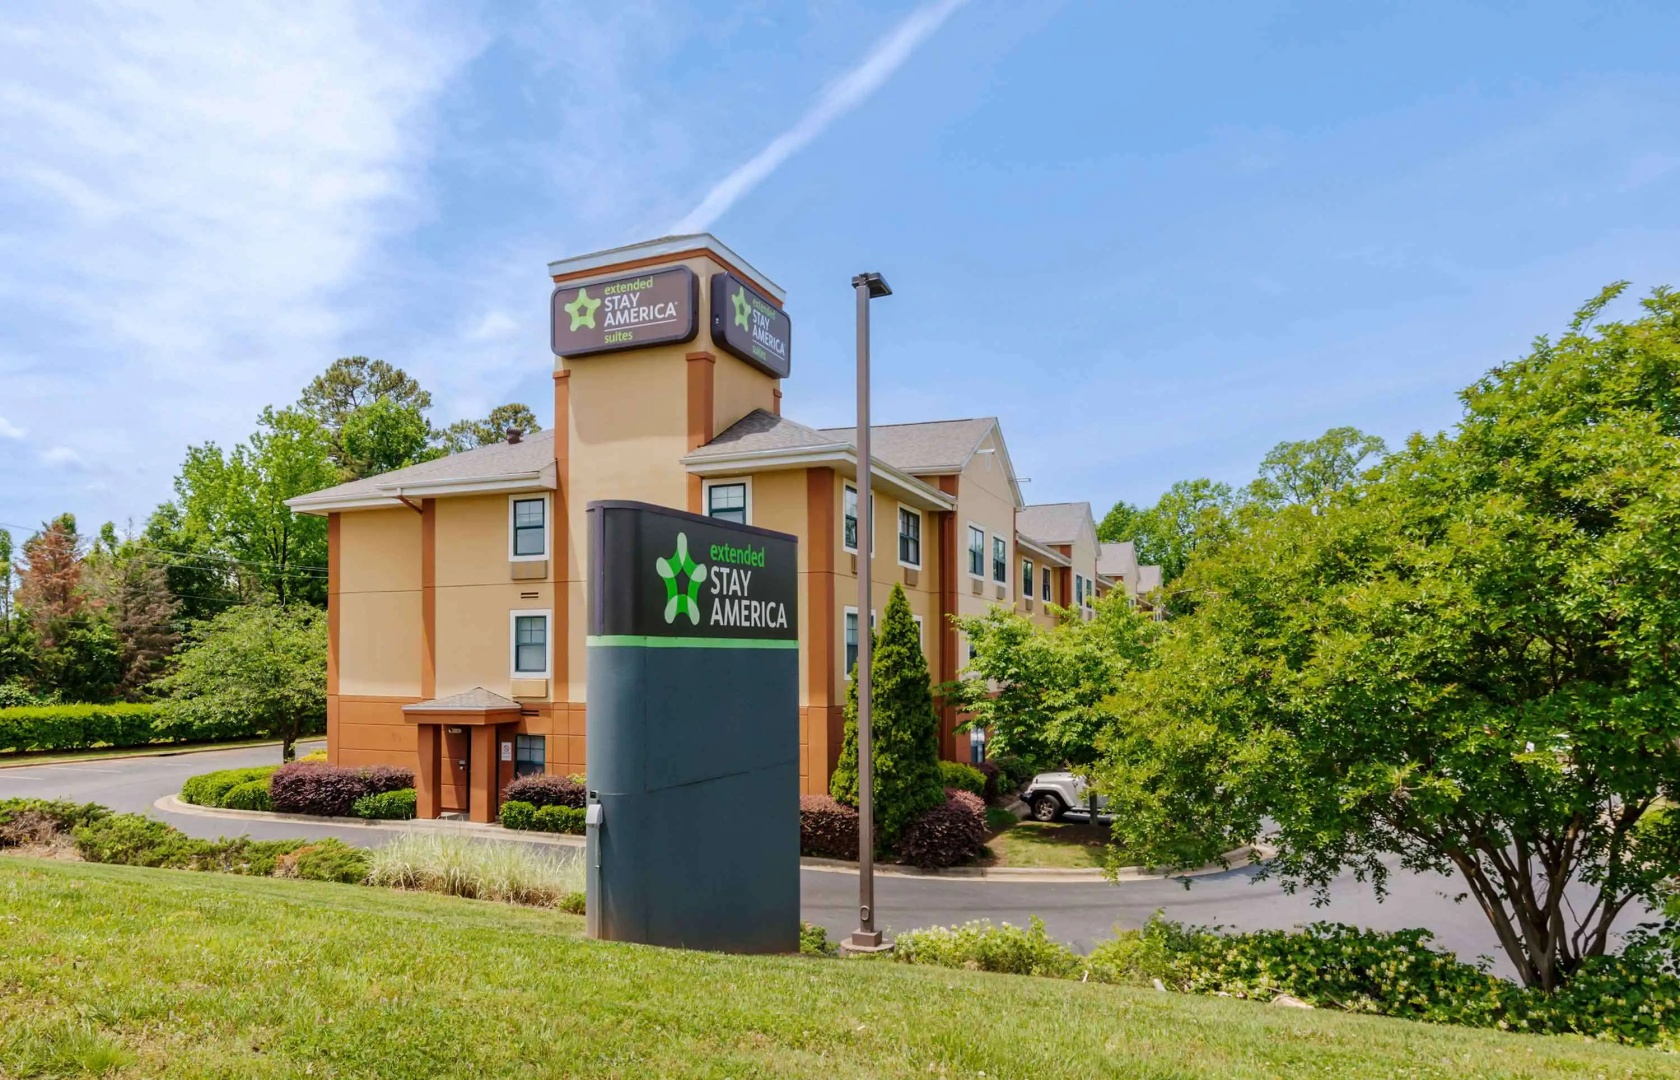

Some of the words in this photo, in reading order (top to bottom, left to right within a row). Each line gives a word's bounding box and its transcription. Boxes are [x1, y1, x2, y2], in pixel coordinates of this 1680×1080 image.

[604, 276, 653, 295] extended
[604, 292, 640, 312] STAY
[604, 302, 677, 328] AMERICA
[752, 309, 770, 331] STAY
[604, 331, 633, 344] suites
[752, 324, 785, 356] AMERICA
[710, 543, 765, 568] extended
[710, 565, 752, 597] STAY
[709, 598, 788, 629] AMERICA
